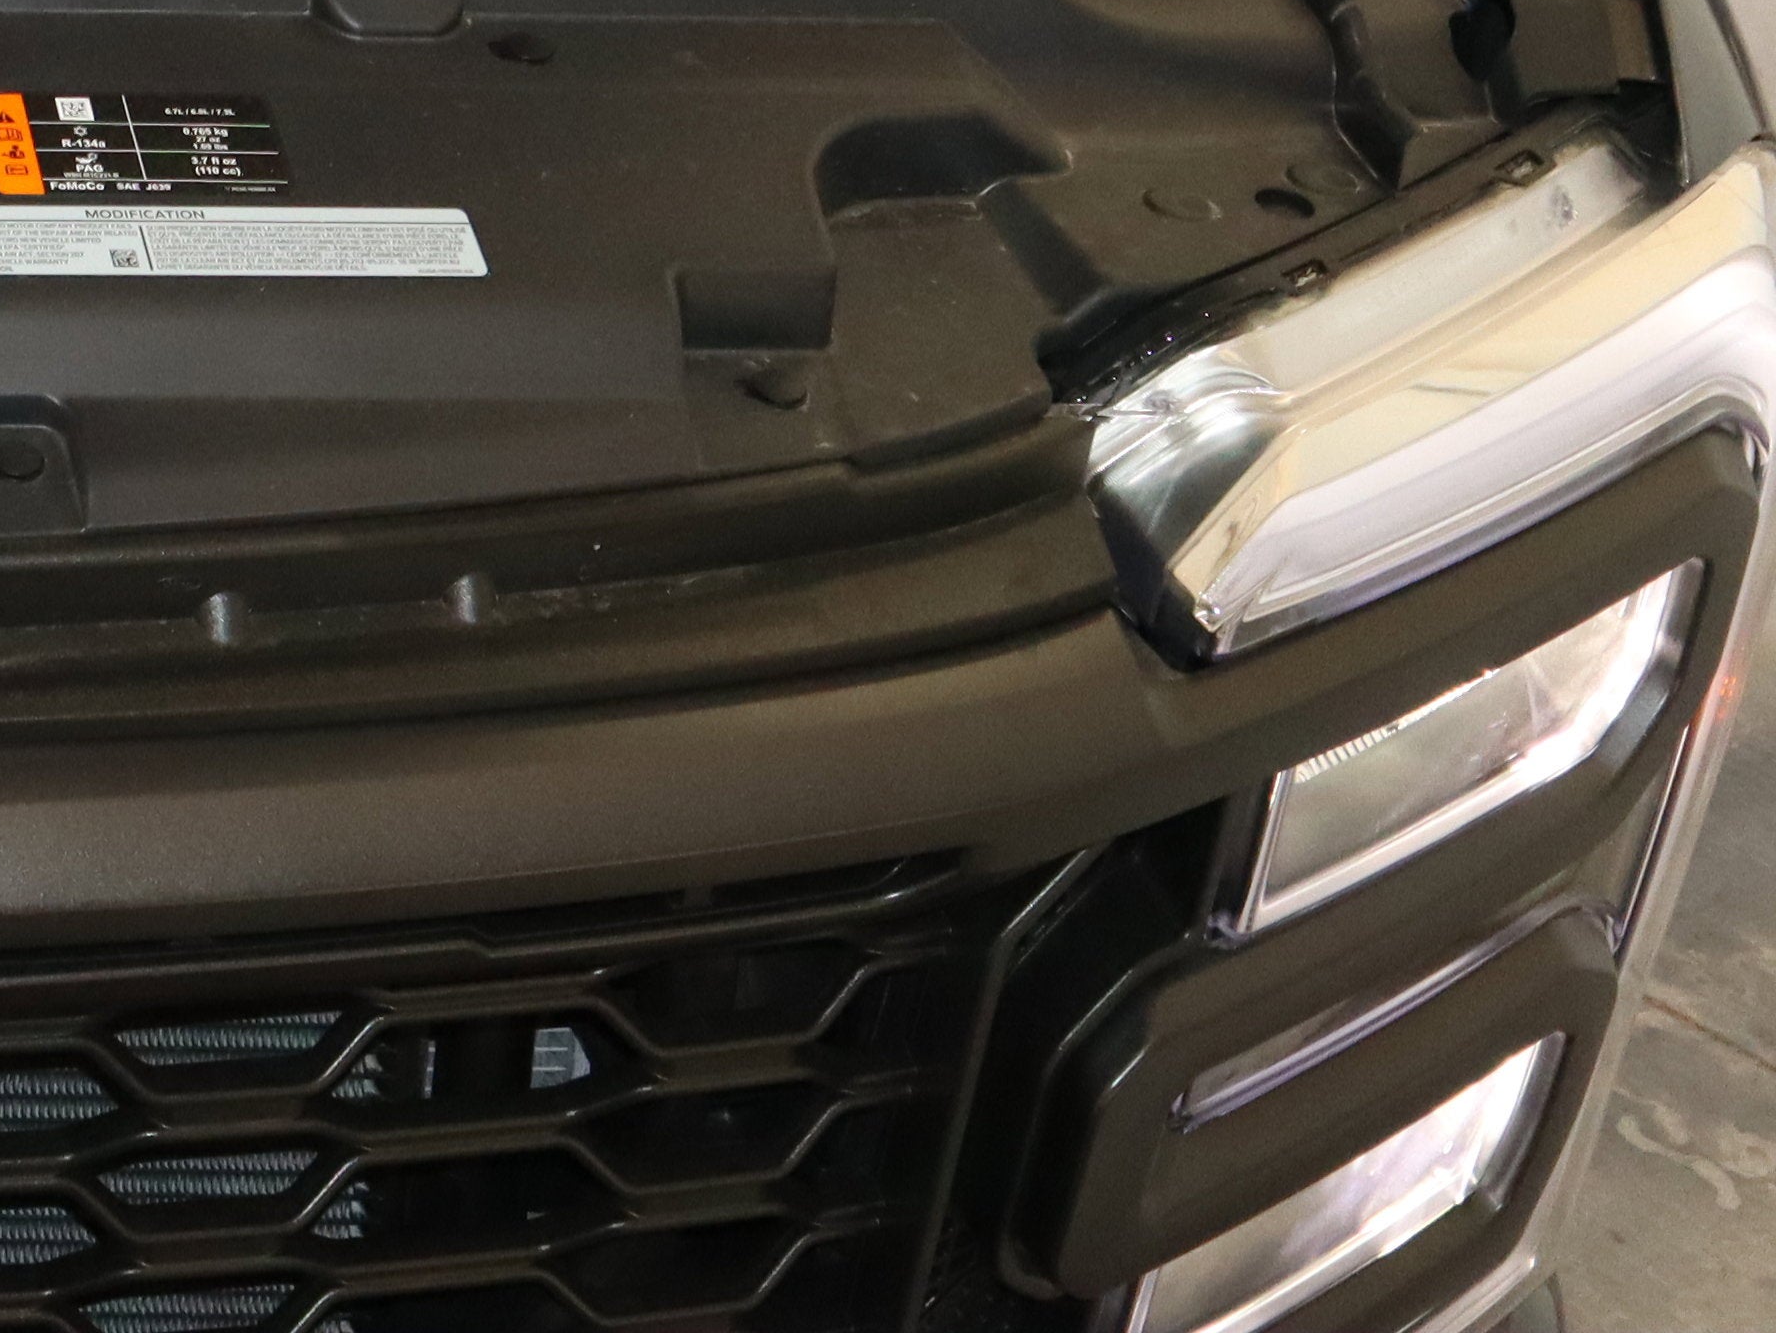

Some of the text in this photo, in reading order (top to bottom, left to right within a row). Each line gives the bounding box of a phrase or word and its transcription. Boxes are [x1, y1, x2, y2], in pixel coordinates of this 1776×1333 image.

[213, 127, 229, 138] kg
[61, 138, 106, 149] R-134a
[190, 156, 208, 165] 3.7
[222, 157, 237, 165] oz
[75, 164, 104, 173] PAG
[195, 166, 220, 176] (110
[49, 181, 172, 191] FoMoCo SAE J639
[84, 208, 206, 221] MODIFICATION
